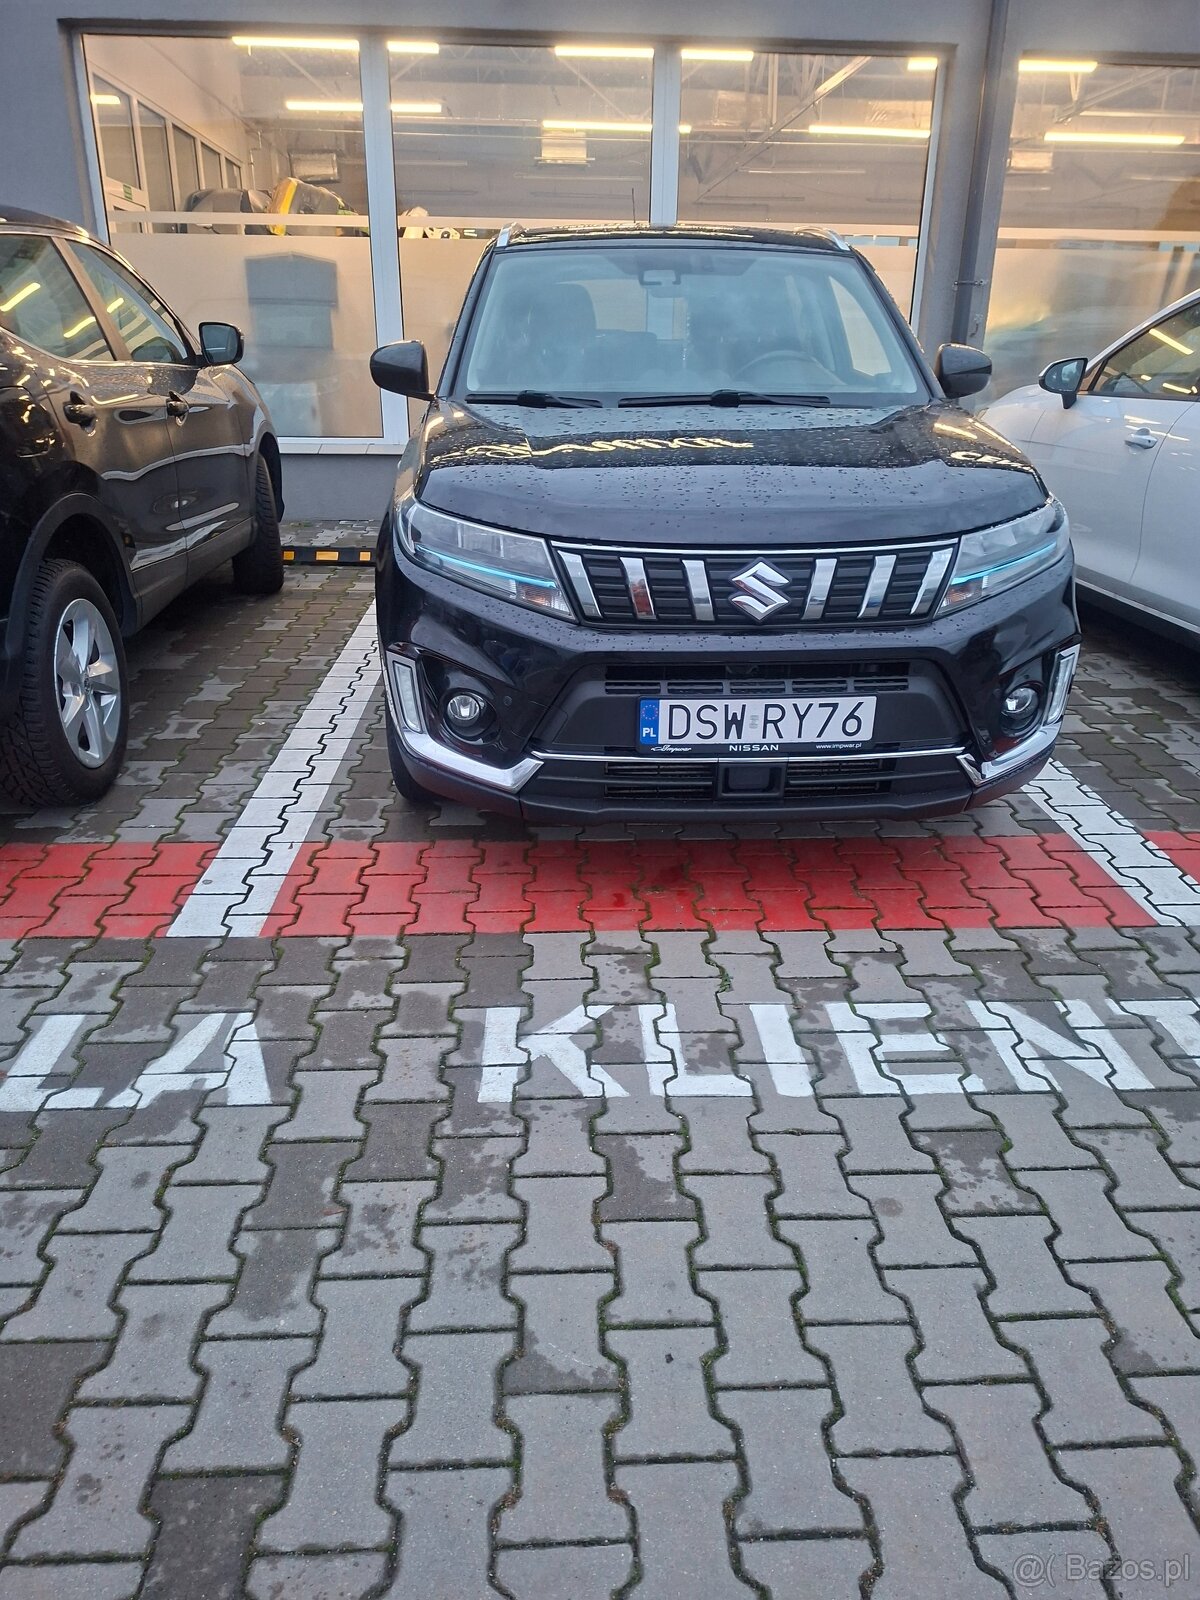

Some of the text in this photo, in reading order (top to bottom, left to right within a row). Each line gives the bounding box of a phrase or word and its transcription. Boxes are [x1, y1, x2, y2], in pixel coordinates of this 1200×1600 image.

[668, 701, 864, 740] DSW RY76
[642, 727, 656, 738] PL
[729, 744, 779, 752] NISSAN
[815, 742, 862, 750] www.impwar.pl
